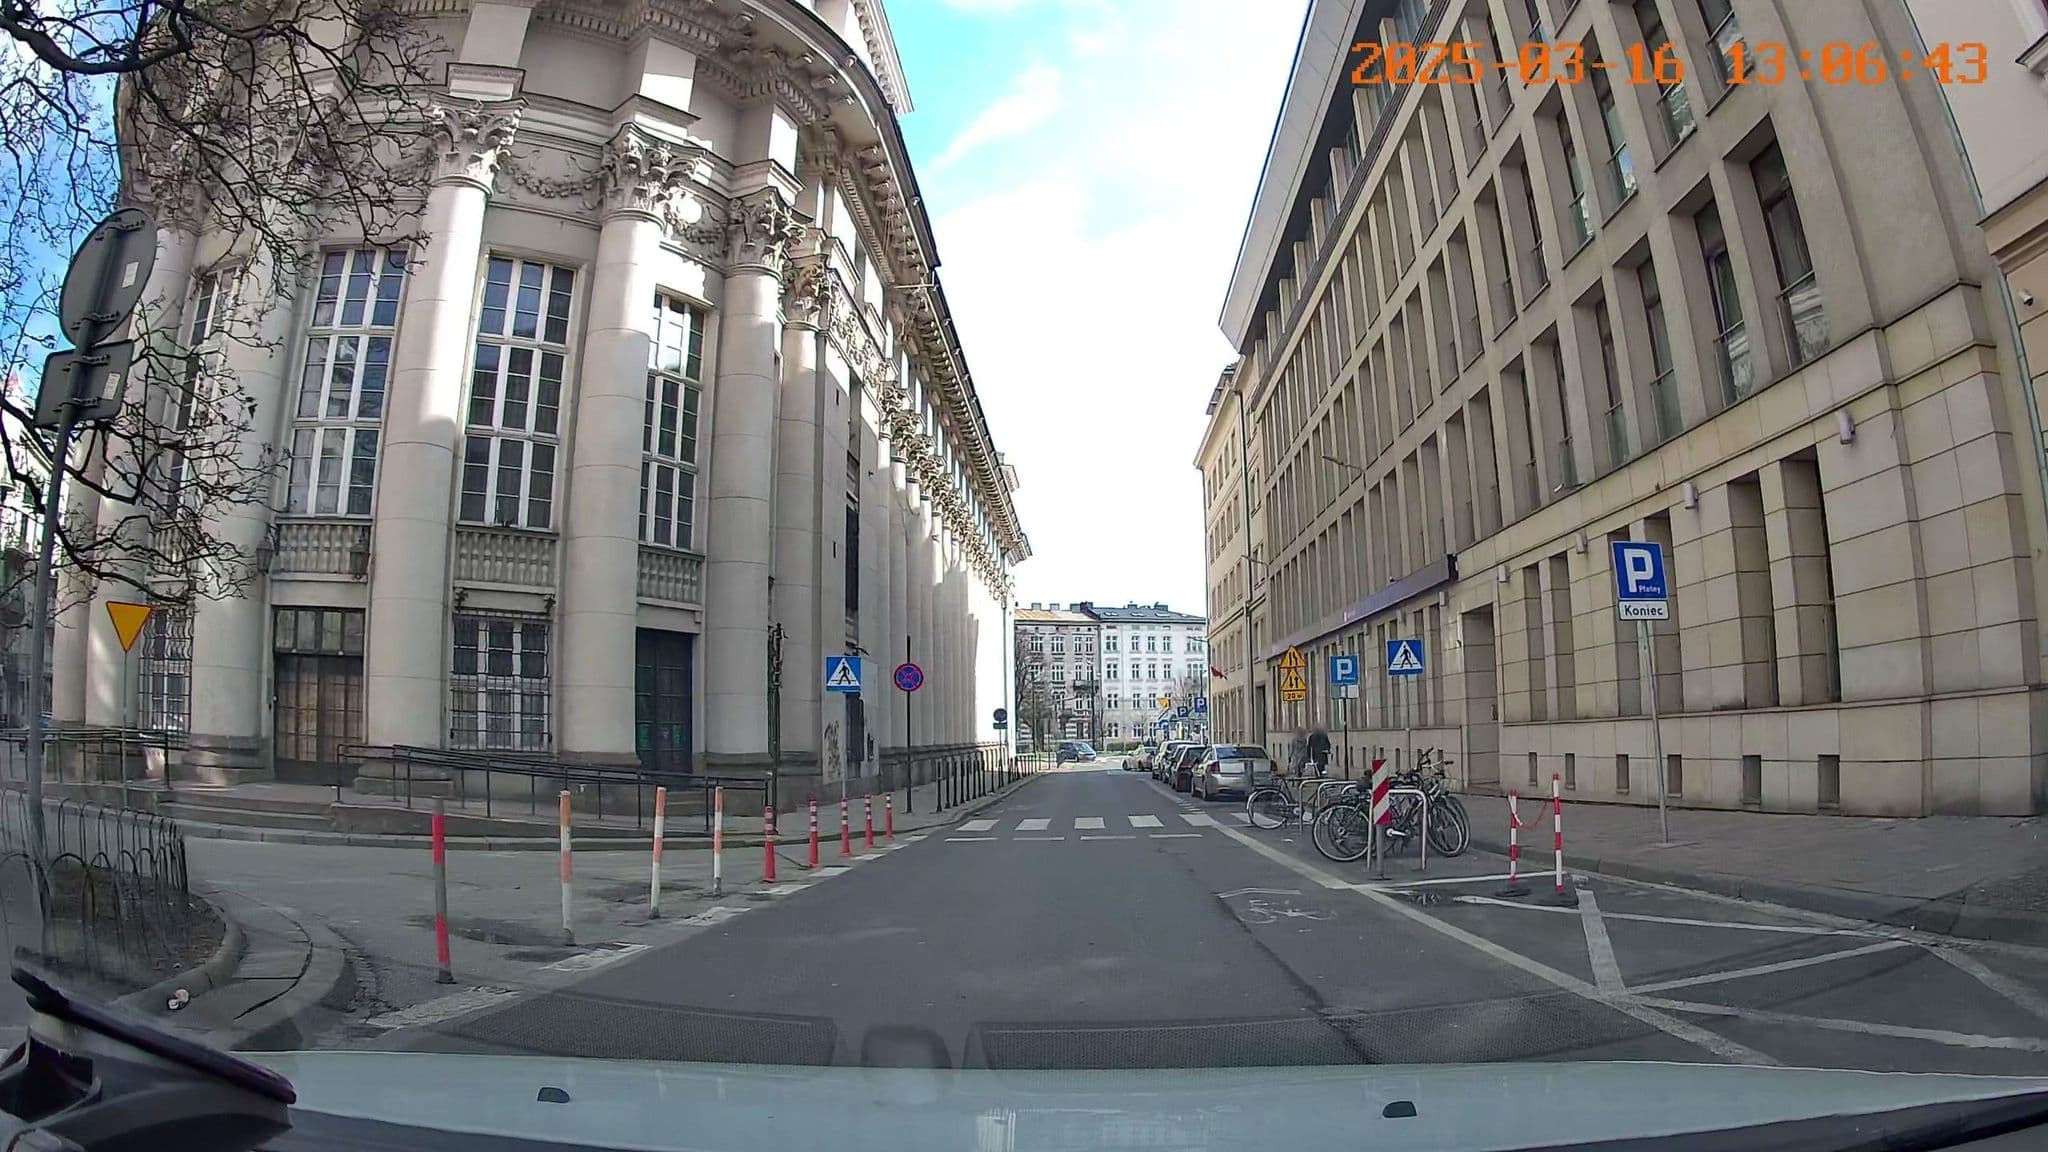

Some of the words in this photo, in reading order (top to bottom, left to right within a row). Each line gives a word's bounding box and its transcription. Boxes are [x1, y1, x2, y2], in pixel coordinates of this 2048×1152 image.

[1623, 548, 1654, 593] P
[1624, 604, 1663, 616] Koniec
[1336, 658, 1353, 681] P
[1197, 698, 1205, 709] P
[1179, 707, 1187, 716] P
